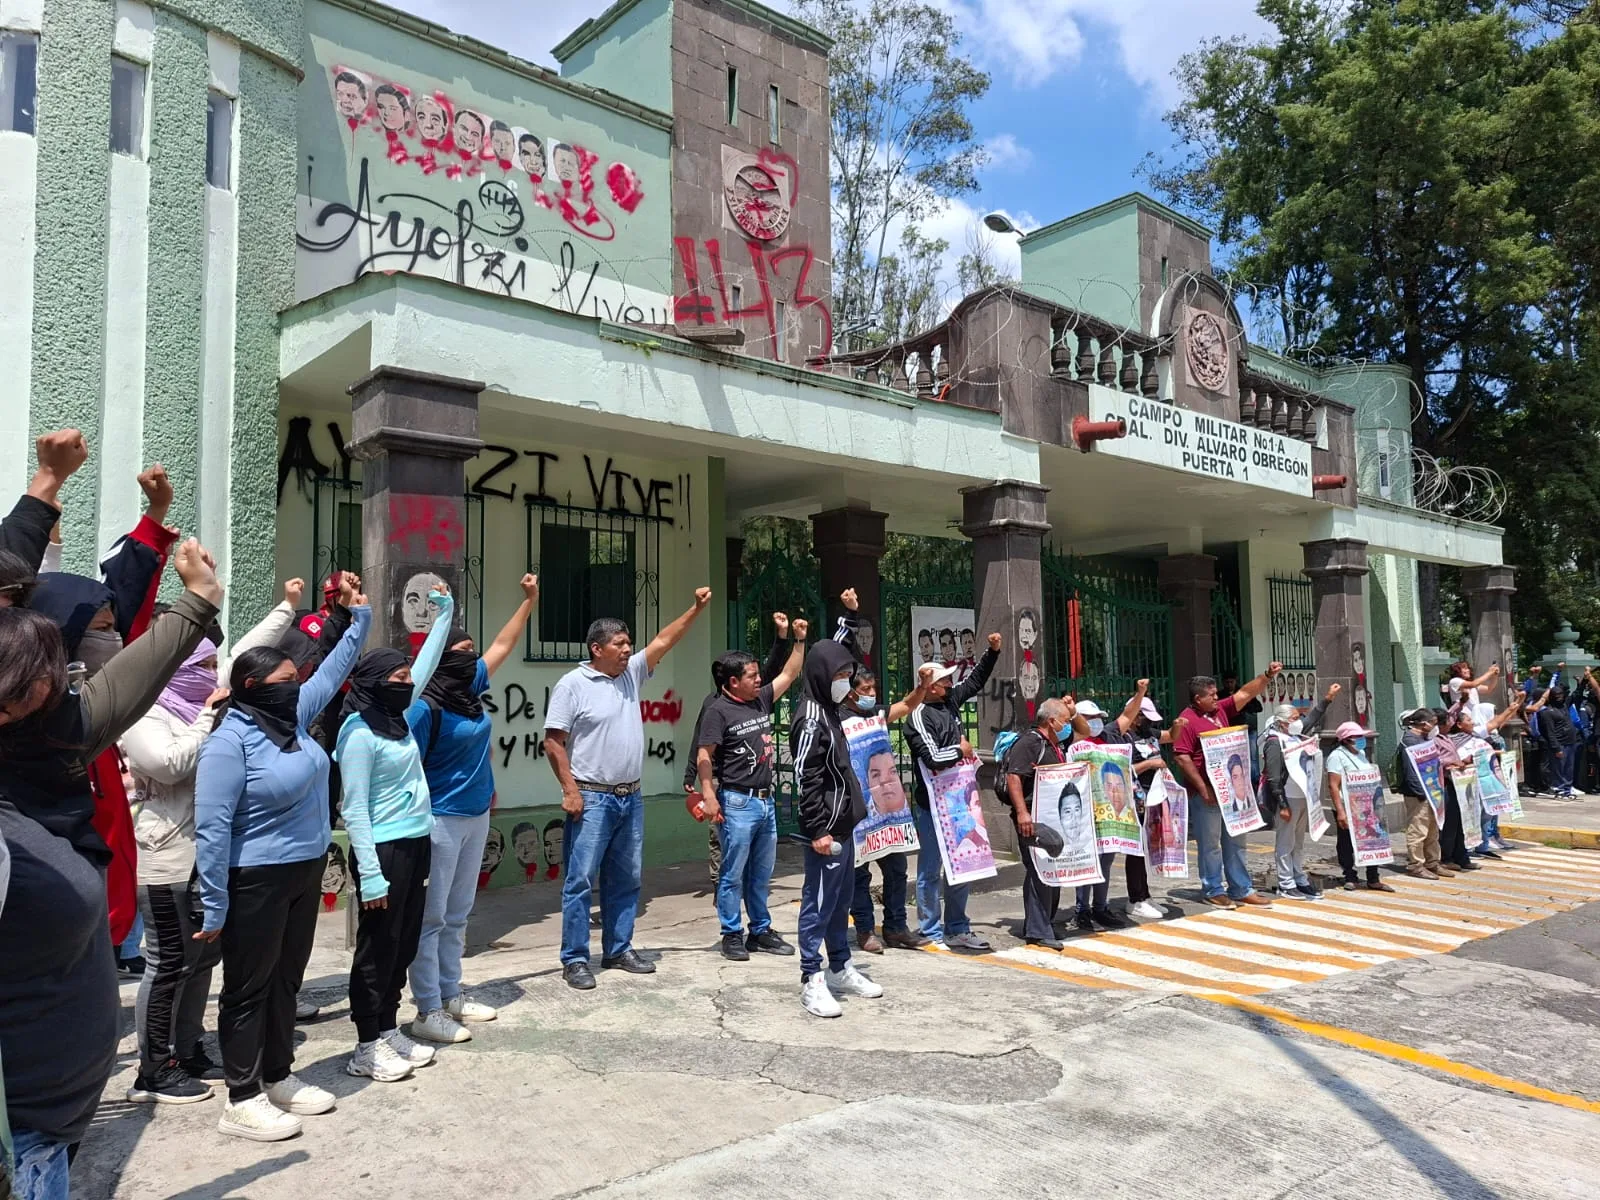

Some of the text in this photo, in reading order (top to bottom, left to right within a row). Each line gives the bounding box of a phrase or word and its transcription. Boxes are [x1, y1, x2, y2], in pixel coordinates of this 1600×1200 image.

[1128, 398, 1182, 428] CAMPO
[1194, 416, 1248, 445] MILITAR
[1164, 427, 1189, 449] DIV.
[1252, 450, 1308, 477] OBREGÓN
[1182, 451, 1249, 481] PUERTA 1
[866, 832, 880, 851] NOS
